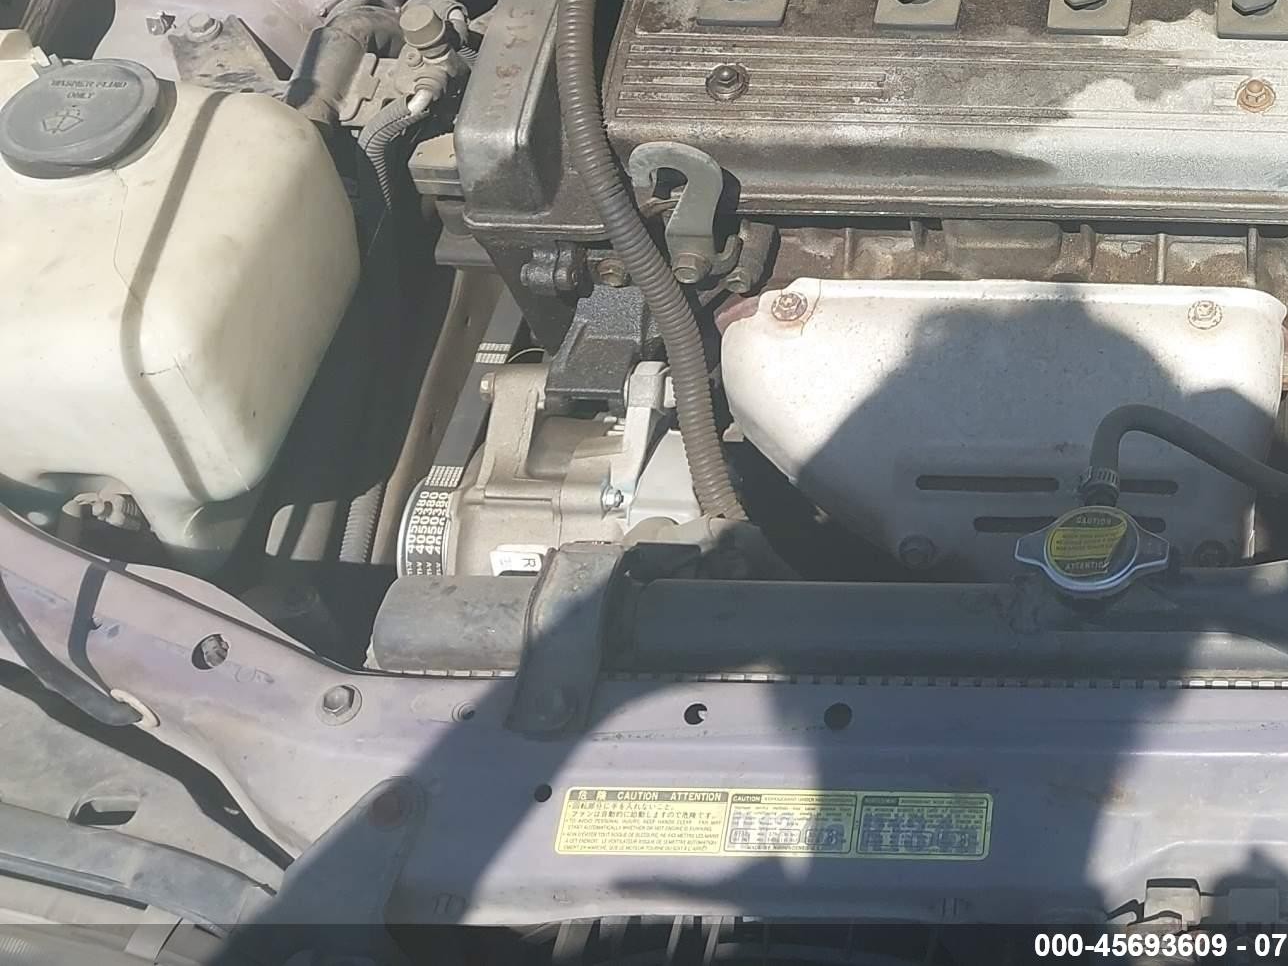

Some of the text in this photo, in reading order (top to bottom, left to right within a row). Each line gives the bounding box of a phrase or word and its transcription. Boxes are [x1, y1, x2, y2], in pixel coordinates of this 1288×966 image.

[416, 491, 439, 555] 4050380
[425, 491, 448, 555] 4050380
[1076, 517, 1112, 525] CAUTION
[617, 792, 721, 802] CAUTION ATTENTION
